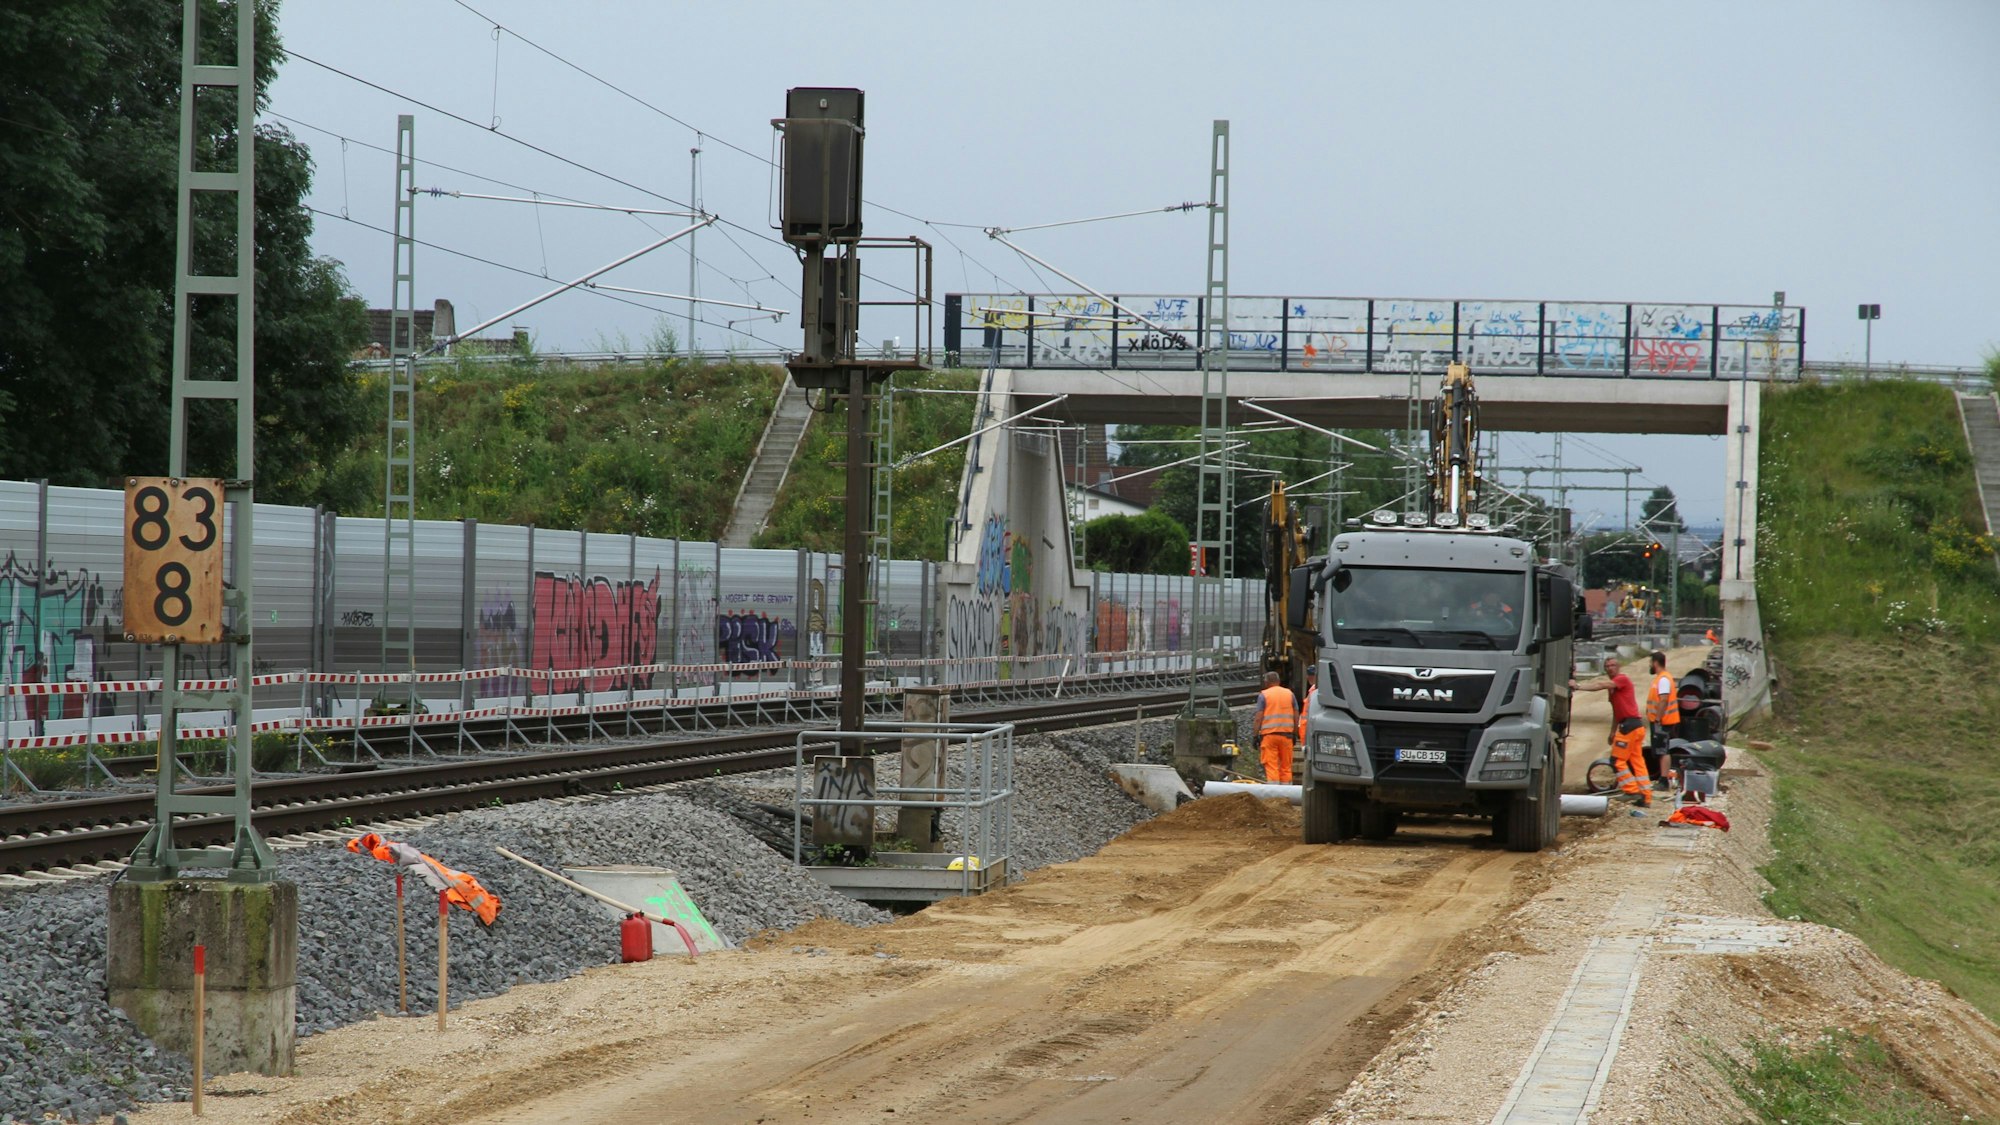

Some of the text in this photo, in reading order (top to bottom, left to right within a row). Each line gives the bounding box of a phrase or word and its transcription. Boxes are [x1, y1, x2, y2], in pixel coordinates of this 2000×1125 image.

[132, 486, 216, 552] 83
[154, 561, 192, 627] 8
[1392, 687, 1453, 702] MAN
[1400, 750, 1445, 761] SU CB 152
